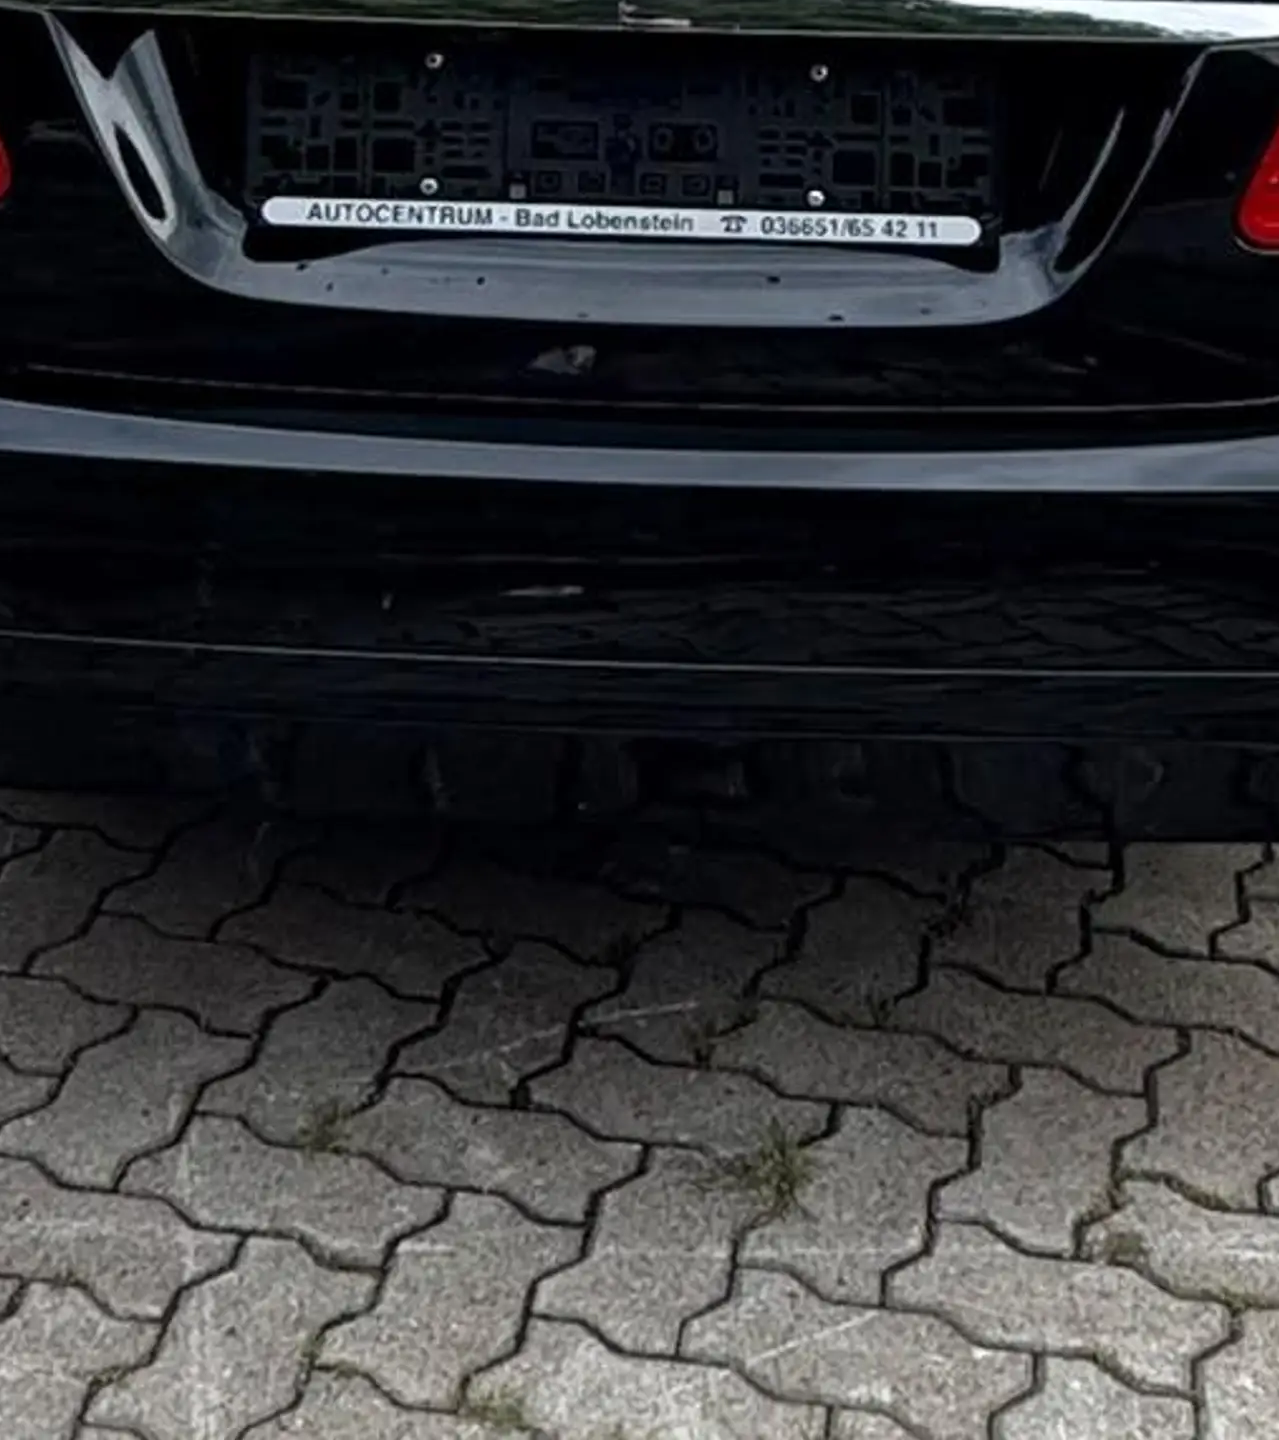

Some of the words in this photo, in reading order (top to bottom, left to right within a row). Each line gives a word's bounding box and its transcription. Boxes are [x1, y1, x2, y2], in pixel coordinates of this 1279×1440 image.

[307, 203, 494, 226] AUTOCENTRUM
[515, 208, 560, 228] Bad
[568, 211, 695, 232] Lobenstein
